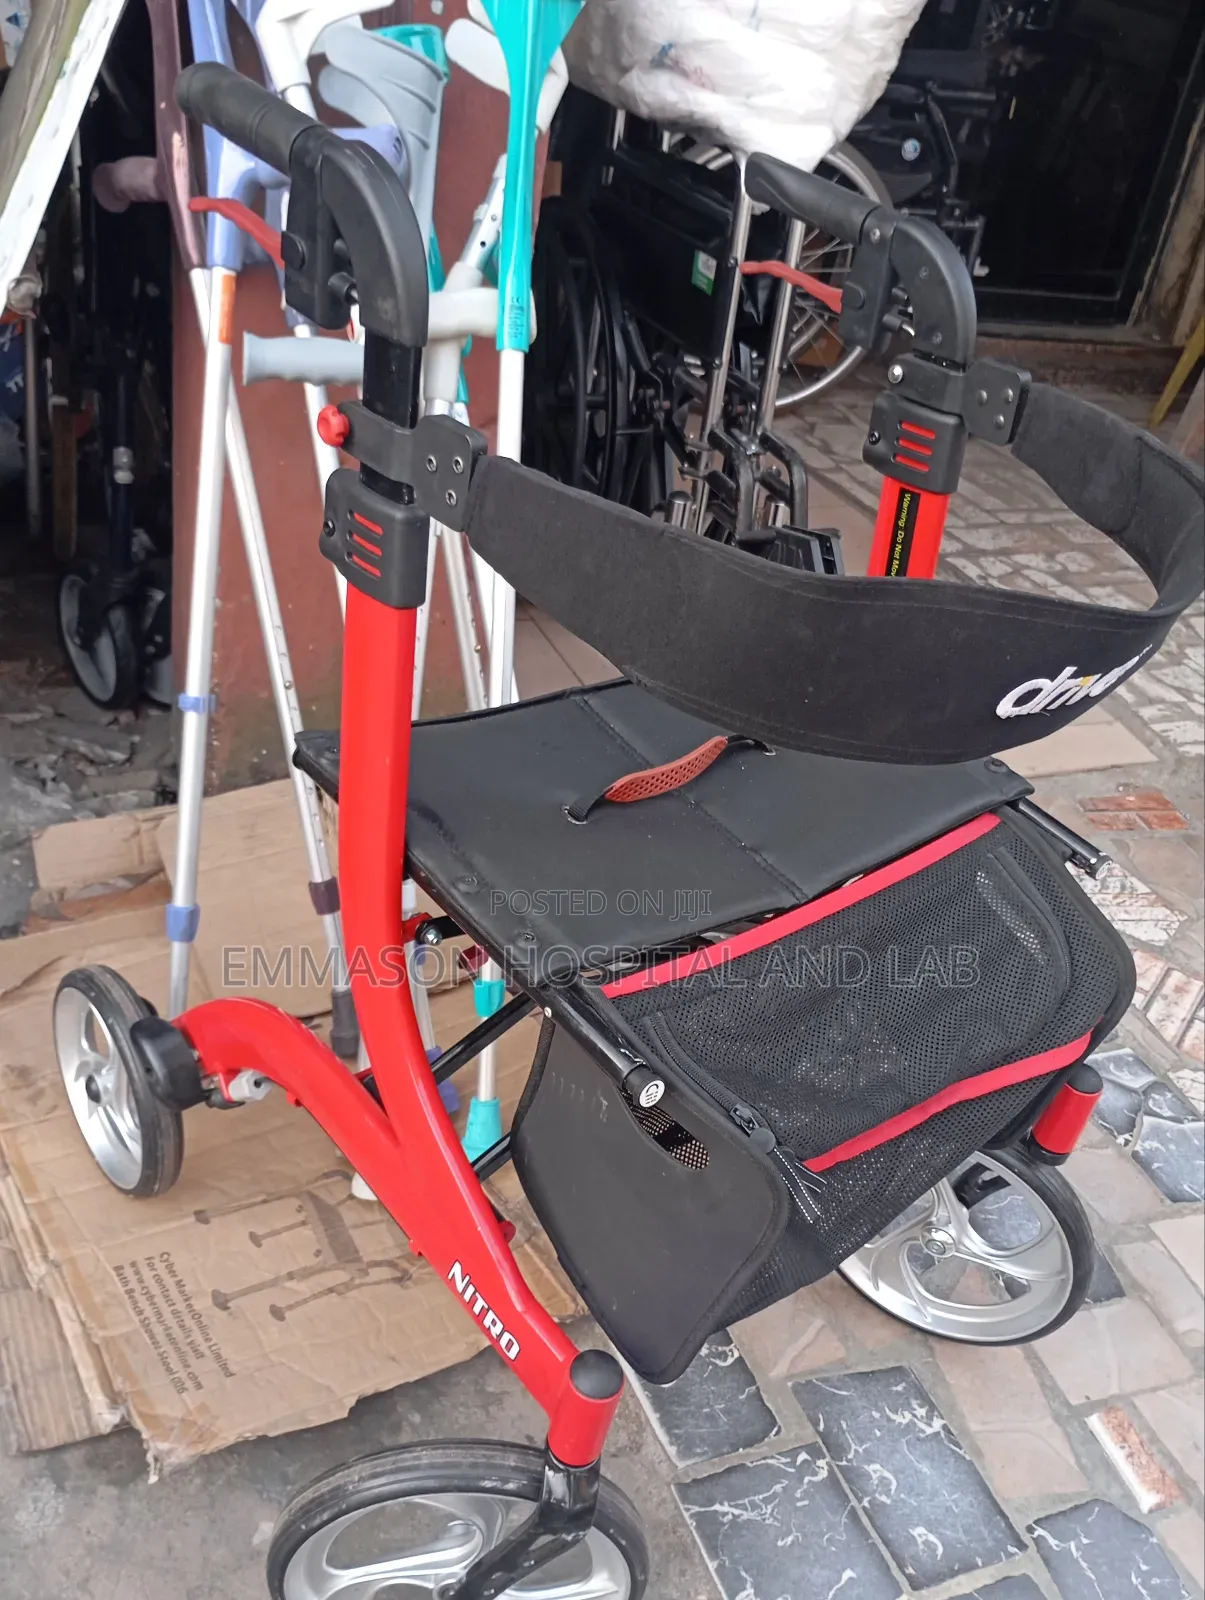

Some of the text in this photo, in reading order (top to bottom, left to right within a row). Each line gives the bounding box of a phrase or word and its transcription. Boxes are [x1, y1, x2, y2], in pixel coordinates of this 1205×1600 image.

[891, 494, 911, 577] Warning: Do Not Mov
[112, 1263, 130, 1288] Bath
[123, 1287, 145, 1317] Bench
[156, 1349, 179, 1376] Stool
[143, 1255, 158, 1272] For
[151, 1272, 176, 1307] contact
[169, 1307, 192, 1339] details
[158, 1250, 179, 1279] Cyber
[207, 1342, 236, 1378] Limited
[447, 1259, 521, 1361] NITRO
